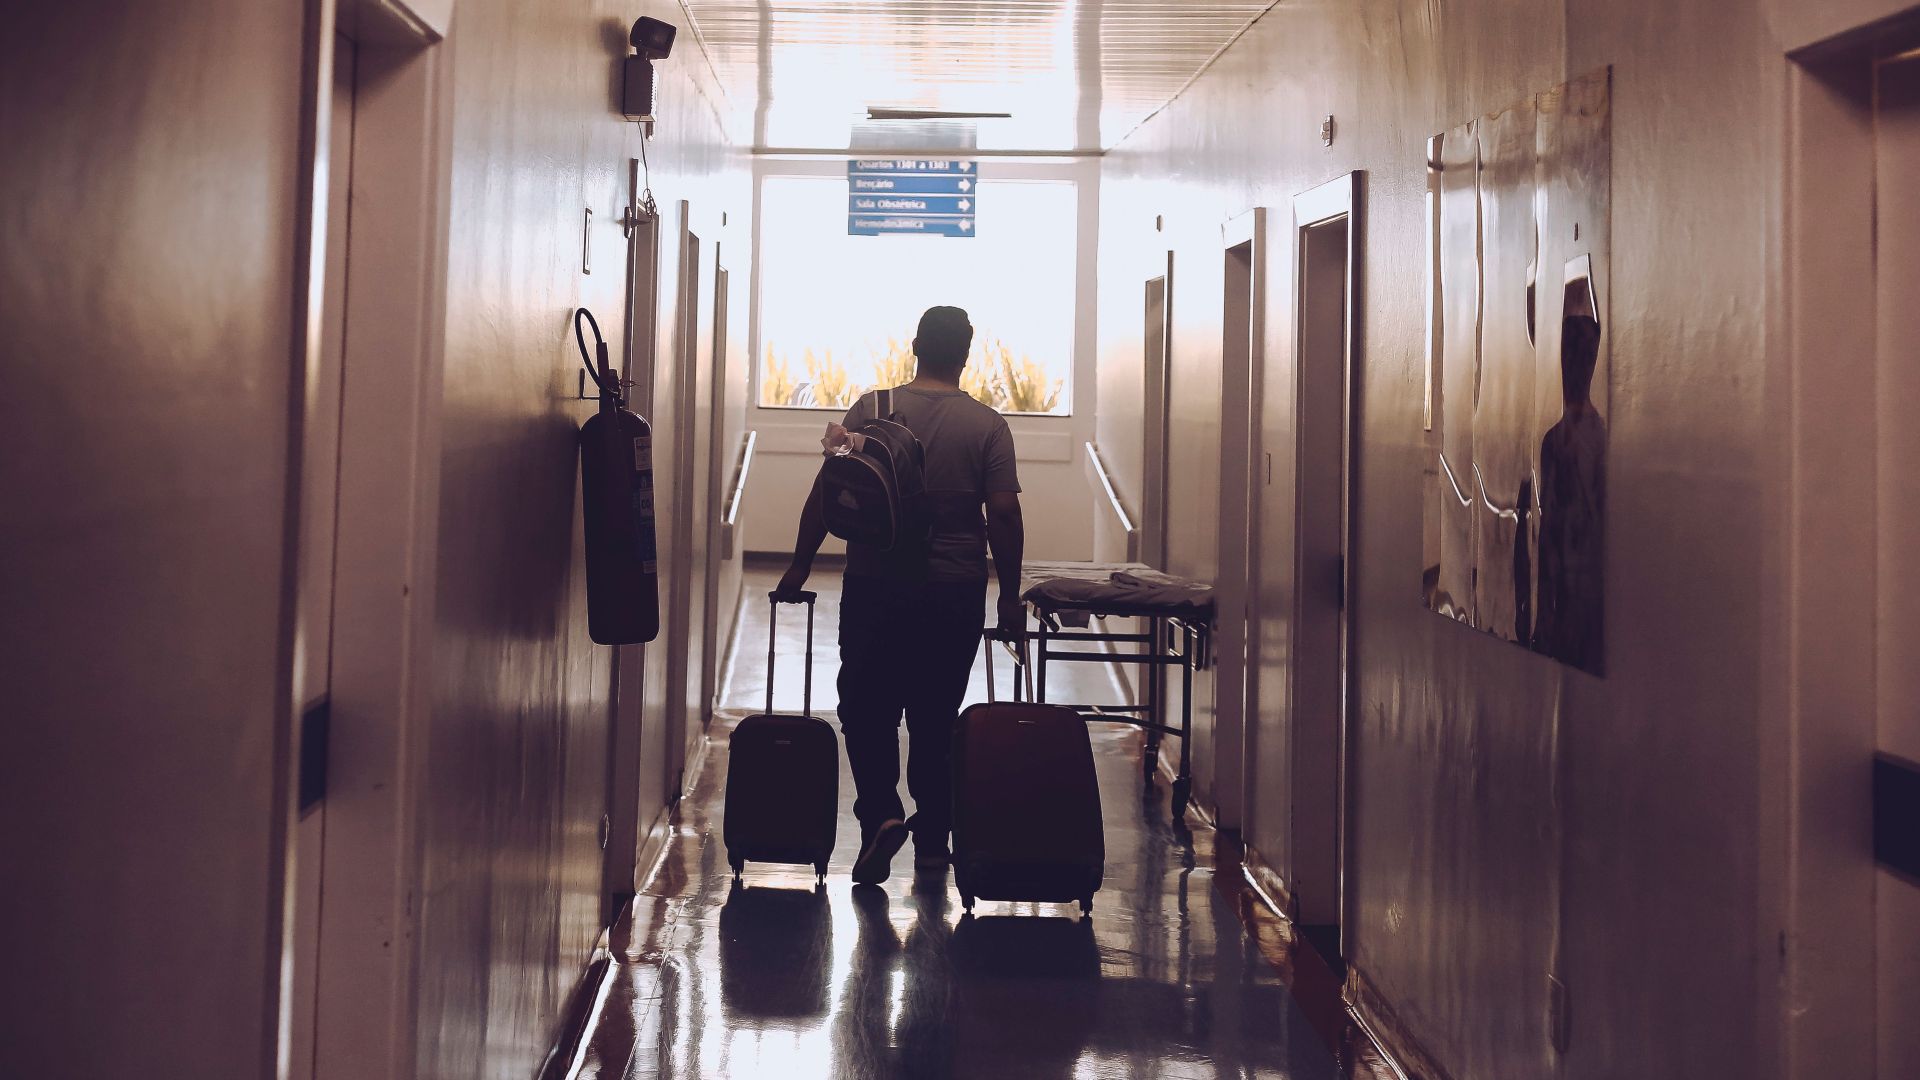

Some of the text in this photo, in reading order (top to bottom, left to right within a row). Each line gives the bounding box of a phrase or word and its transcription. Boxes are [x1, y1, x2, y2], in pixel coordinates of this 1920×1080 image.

[919, 161, 926, 169] a
[856, 199, 926, 208] Sala Obstétrica
